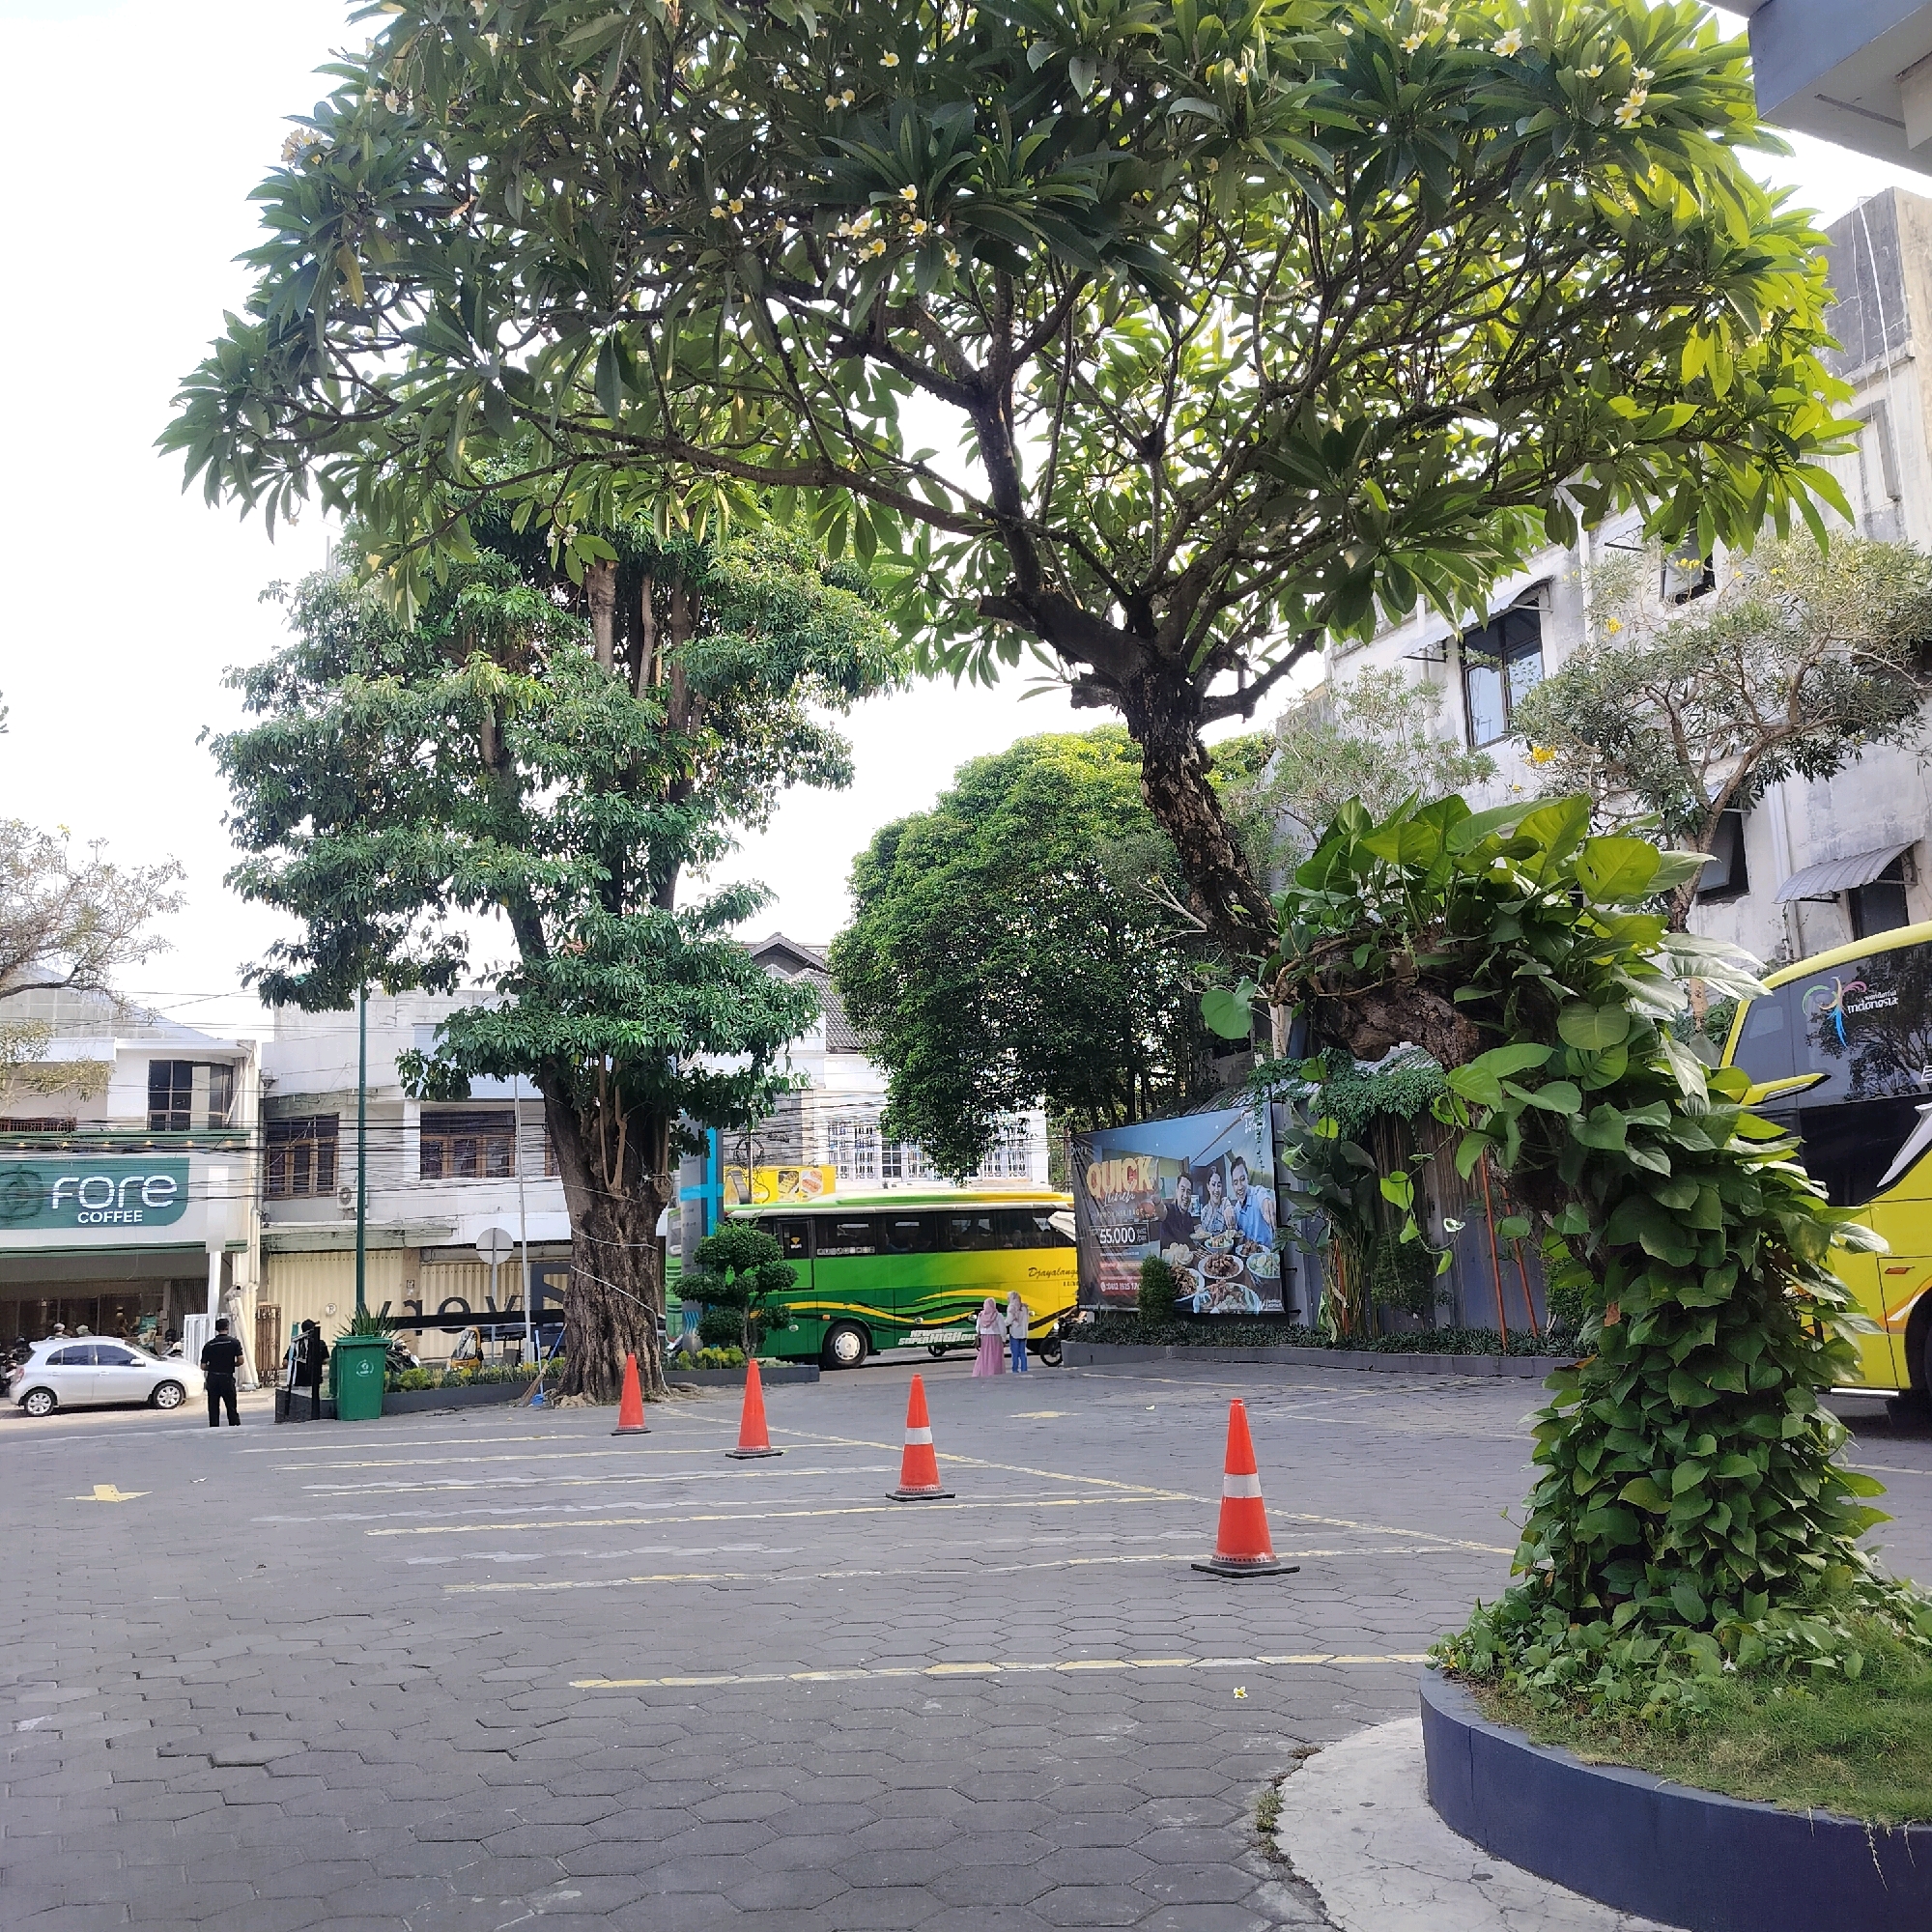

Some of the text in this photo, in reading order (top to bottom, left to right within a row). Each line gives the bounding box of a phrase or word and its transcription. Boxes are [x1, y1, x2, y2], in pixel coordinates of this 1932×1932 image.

[1086, 1156, 1154, 1198] QUICK
[77, 1209, 143, 1224] COFFEE
[1099, 1227, 1136, 1244] 55.000
[929, 1332, 963, 1344] HIGH
